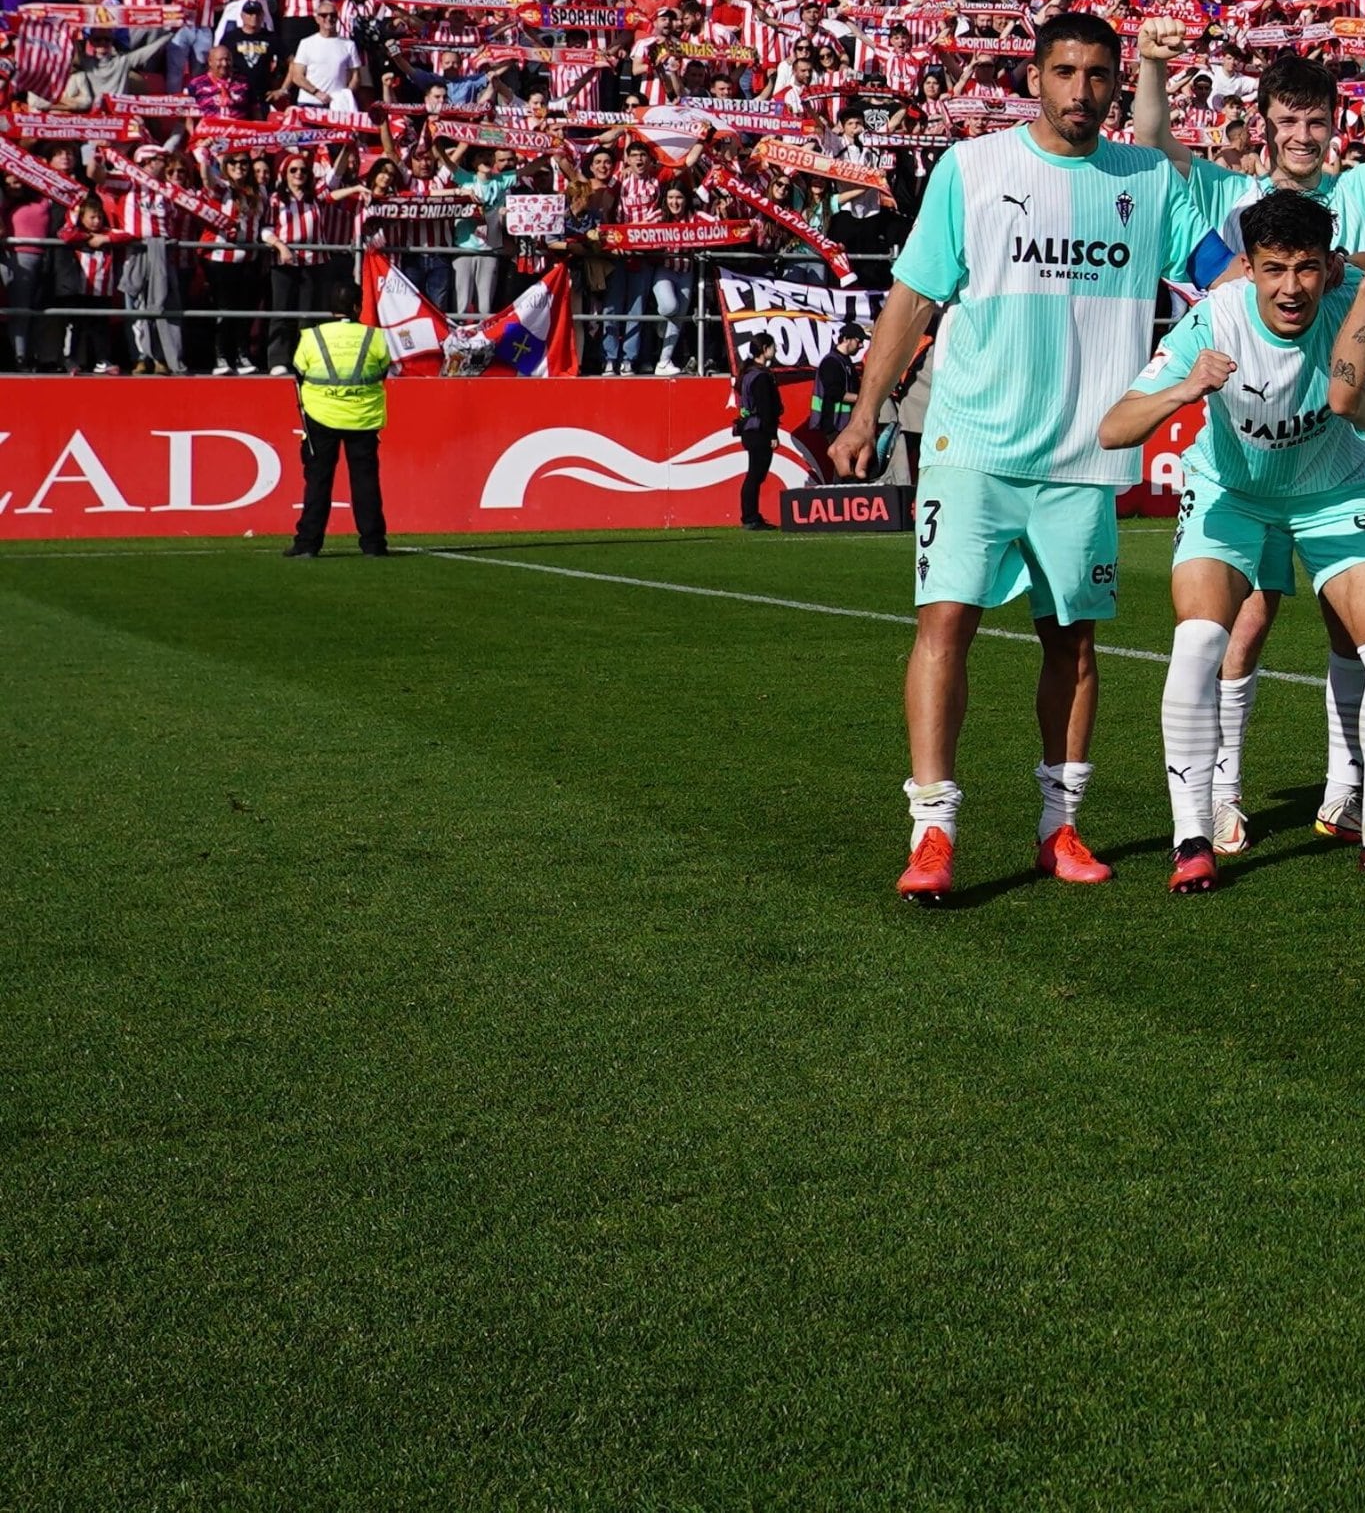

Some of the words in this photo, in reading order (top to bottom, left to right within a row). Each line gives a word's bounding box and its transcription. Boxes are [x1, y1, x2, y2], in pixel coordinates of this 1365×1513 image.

[552, 6, 617, 27] SPORTING
[956, 38, 999, 50] SPORTING
[1012, 39, 1036, 51] GIJO
[693, 97, 769, 113] SPORTING
[719, 113, 781, 130] SPORTING
[401, 204, 417, 218] DE
[420, 203, 477, 218] SPORTING
[627, 226, 681, 244] SPORTING
[682, 227, 695, 241] de
[1012, 236, 1131, 269] JALISCO
[1039, 270, 1052, 280] ES
[1055, 268, 1099, 282] MÉXICO
[1240, 403, 1333, 441] JALISC
[792, 496, 889, 525] LALIGA
[919, 499, 942, 549] 3
